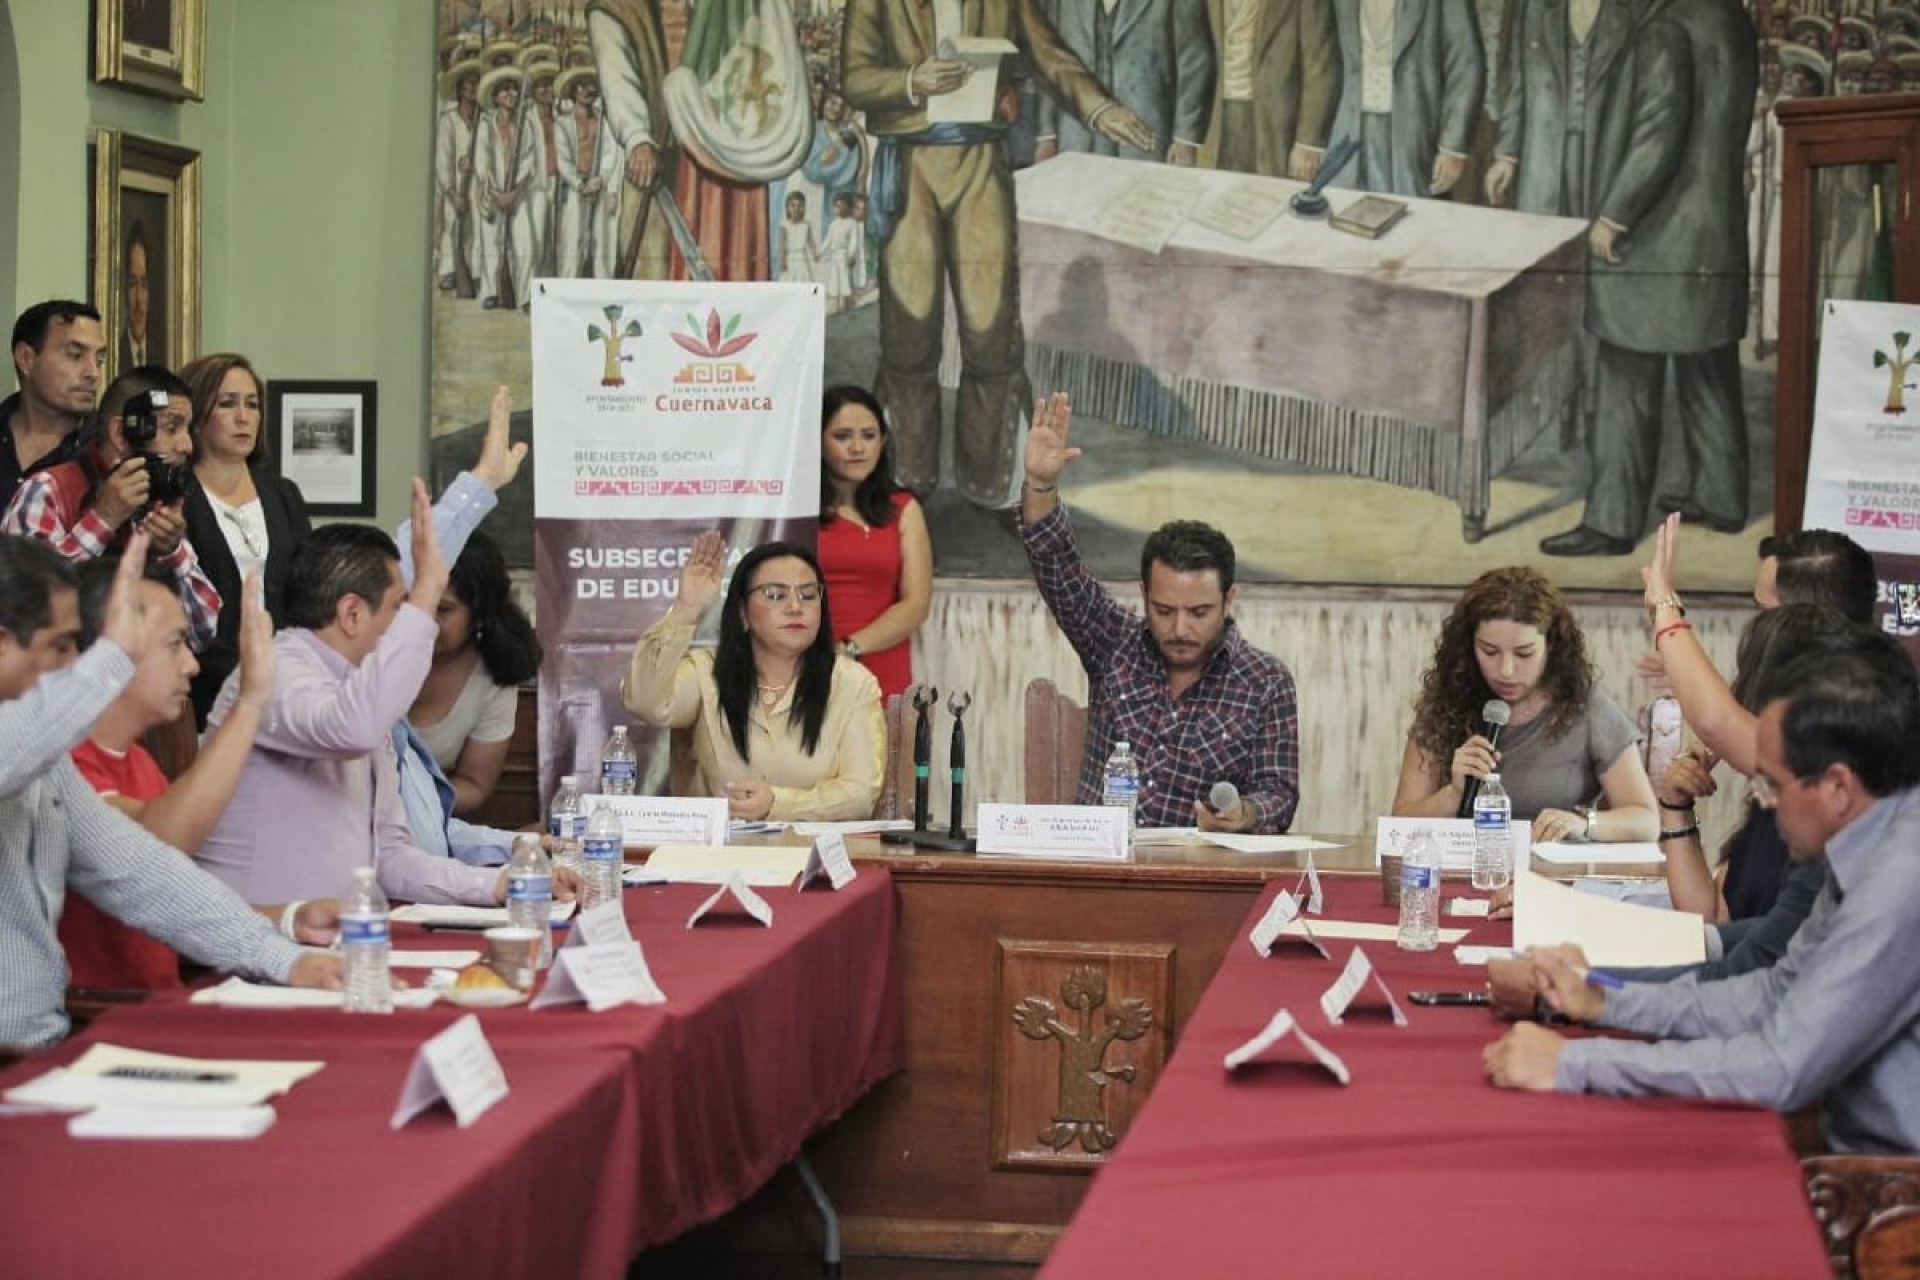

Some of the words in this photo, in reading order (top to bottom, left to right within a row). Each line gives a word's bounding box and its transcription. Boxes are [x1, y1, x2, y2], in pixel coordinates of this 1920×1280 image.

[655, 395, 773, 412] Cuernavaca
[574, 450, 657, 462] BIENESTAR
[661, 449, 716, 462] SOCIAL
[575, 464, 584, 477] Y
[588, 464, 659, 478] VALORES
[577, 578, 615, 599] DE
